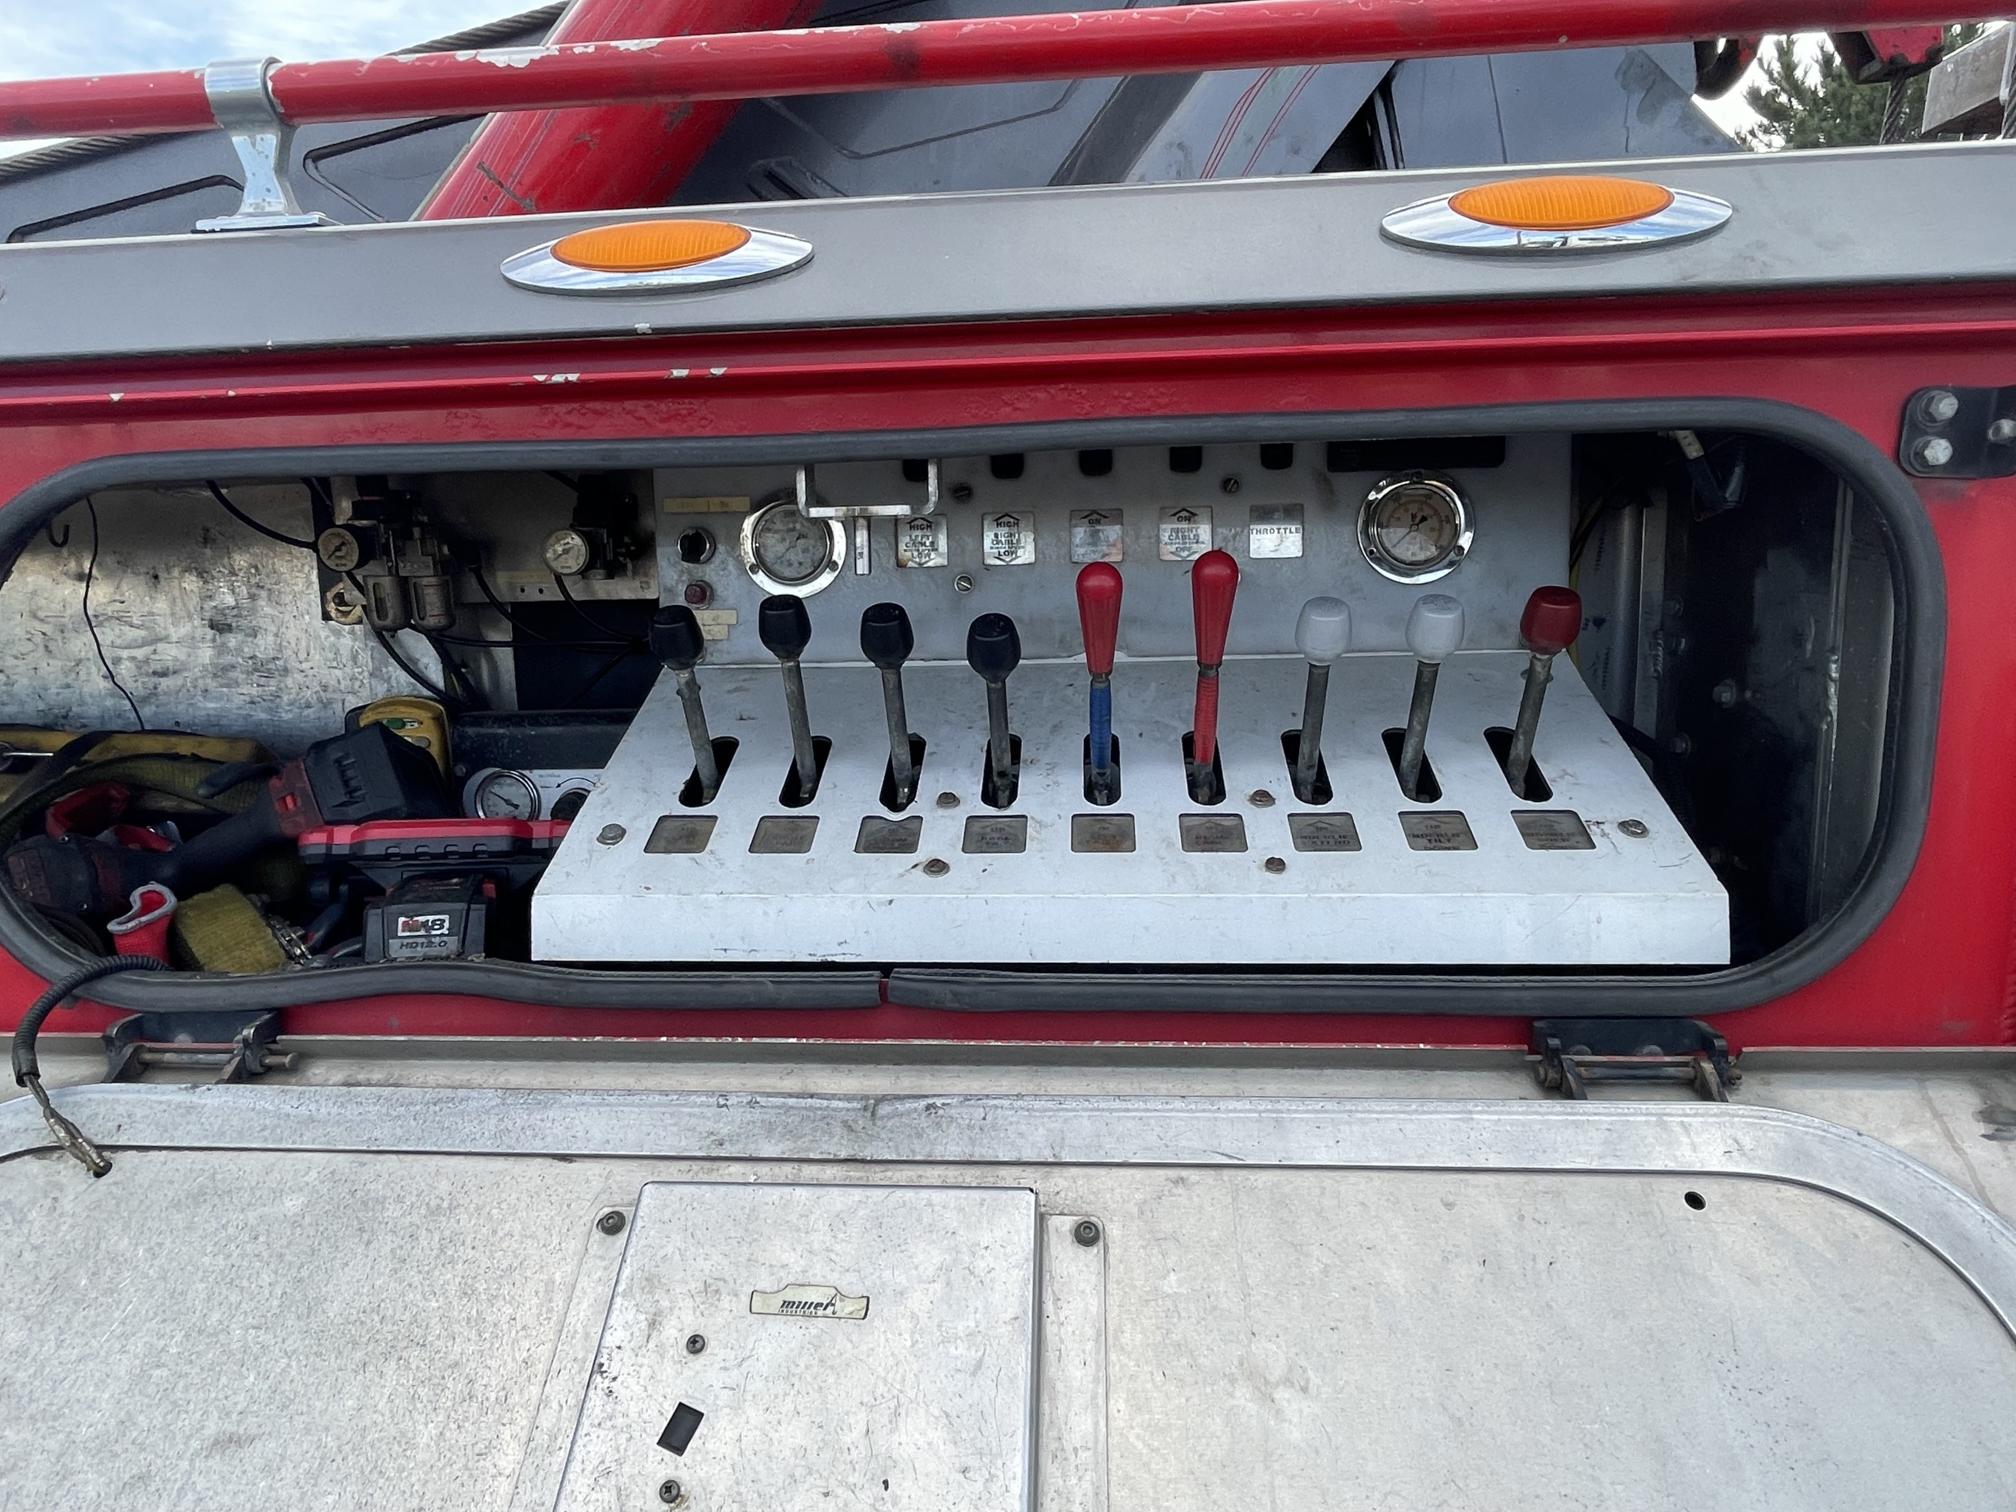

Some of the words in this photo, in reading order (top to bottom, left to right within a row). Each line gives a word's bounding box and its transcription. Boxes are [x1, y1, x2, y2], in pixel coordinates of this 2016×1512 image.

[909, 523, 933, 531] HIGH
[996, 520, 1020, 528] HIGH
[1250, 527, 1301, 535] THROTTLE
[911, 551, 932, 559] LOW
[998, 549, 1018, 557] LOW
[399, 940, 448, 950] HD12.0
